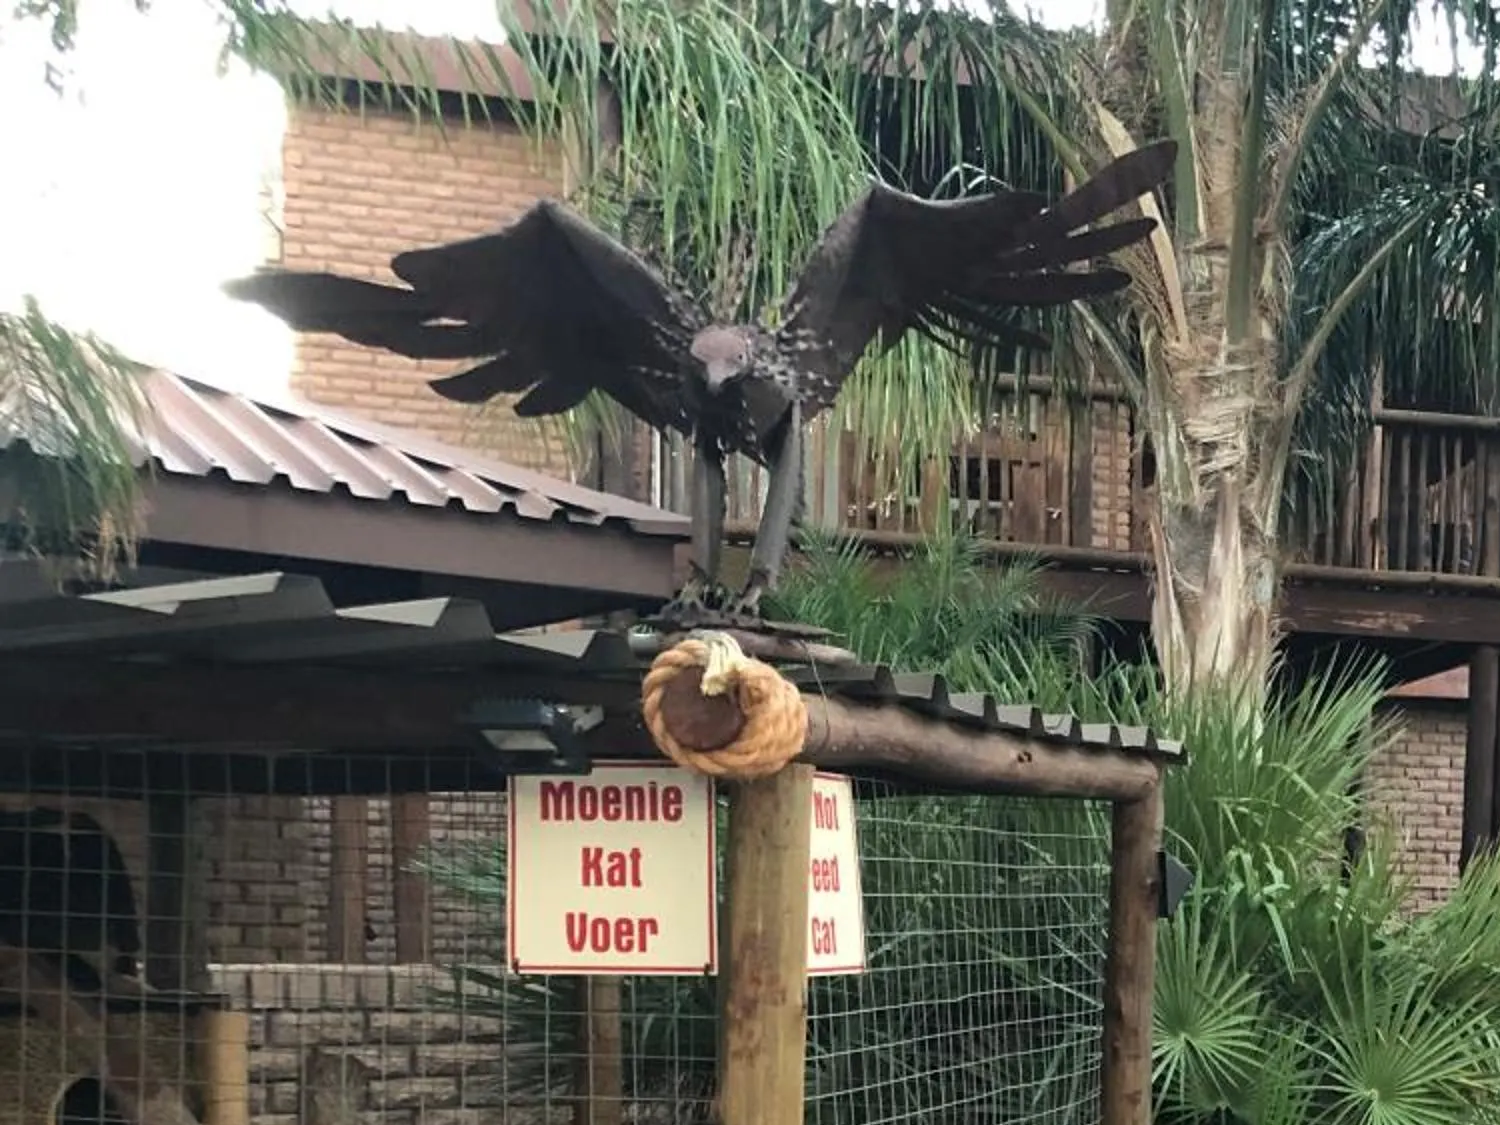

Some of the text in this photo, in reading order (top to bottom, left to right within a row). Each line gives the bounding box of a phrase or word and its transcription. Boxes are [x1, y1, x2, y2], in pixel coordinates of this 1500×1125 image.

[540, 781, 683, 822] Moenie
[813, 791, 840, 831] Not
[581, 847, 642, 887] Kat
[809, 855, 840, 892] eed
[565, 912, 658, 952] Voer
[811, 917, 837, 955] Cat
